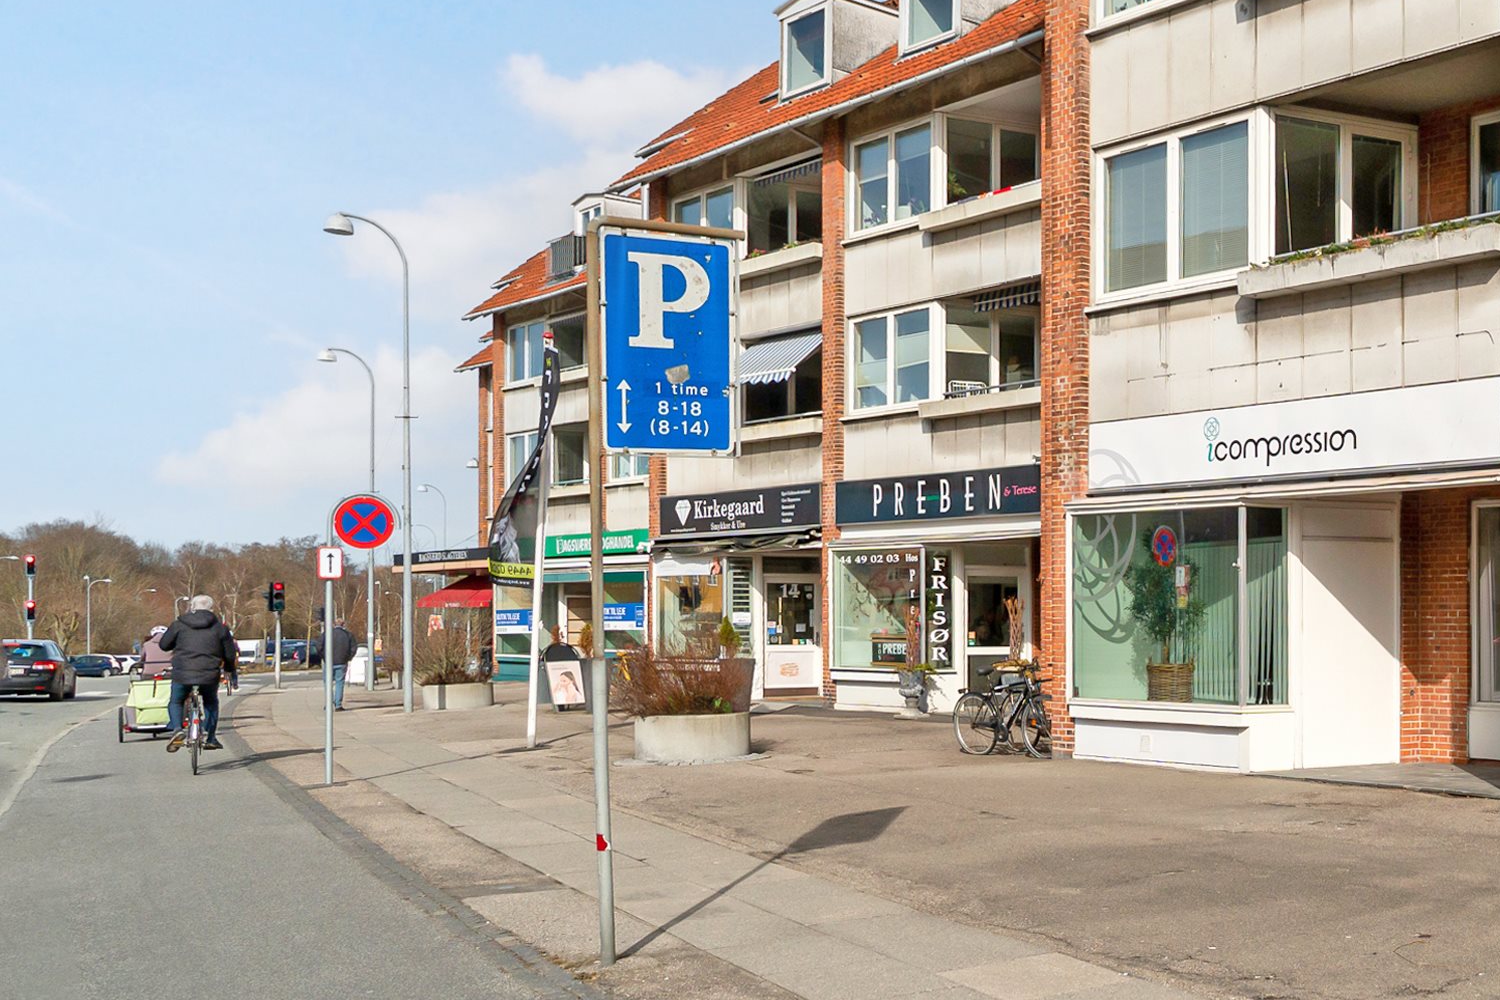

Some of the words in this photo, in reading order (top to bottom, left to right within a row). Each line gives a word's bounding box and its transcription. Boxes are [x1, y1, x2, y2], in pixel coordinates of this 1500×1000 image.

[627, 252, 710, 349] P
[655, 381, 661, 394] 1
[671, 383, 708, 396] time
[658, 400, 702, 416] 8-18
[650, 418, 709, 437] (8-14)
[1208, 429, 1357, 466] icompression
[873, 473, 1001, 517] PREBEN
[1011, 485, 1037, 495] Terese
[693, 494, 764, 520] Kirkegaard
[855, 555, 867, 563] 49
[870, 555, 883, 563] 02
[886, 554, 899, 562] 03
[780, 583, 800, 599] 14
[930, 556, 949, 661] FRISØR
[883, 643, 907, 655] PREBE
